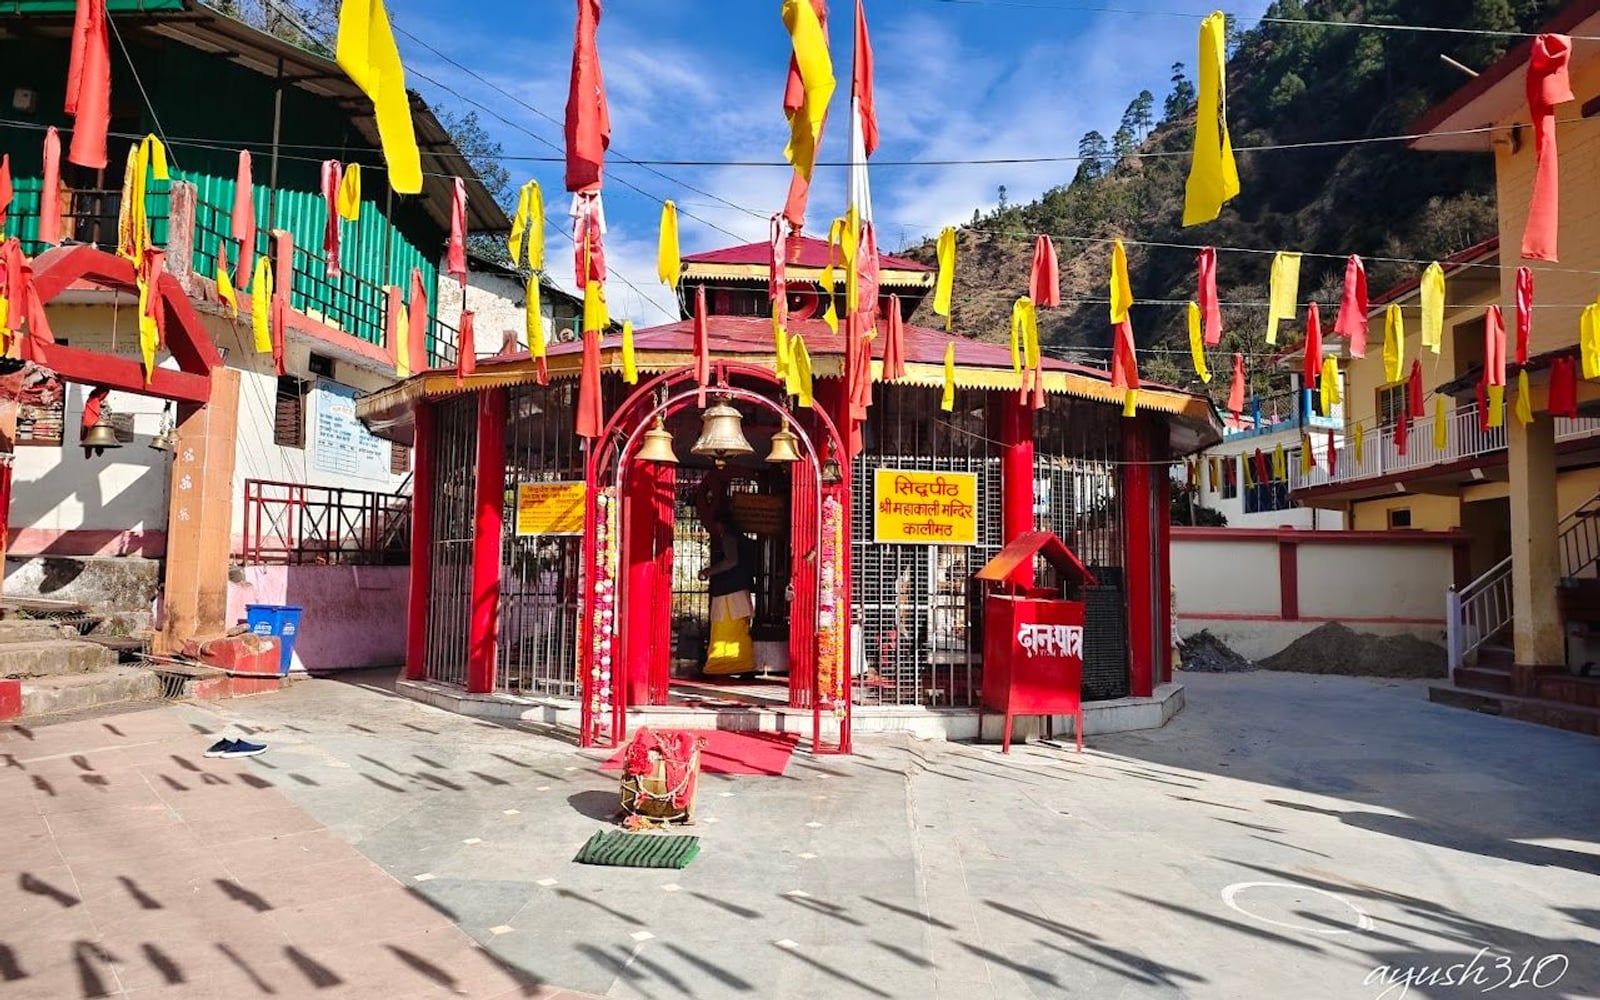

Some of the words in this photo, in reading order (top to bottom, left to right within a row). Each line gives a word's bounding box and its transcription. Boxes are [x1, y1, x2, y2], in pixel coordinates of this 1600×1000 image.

[880, 497, 892, 515] श्री
[893, 499, 940, 517] महाकाली
[942, 499, 974, 519] मन्दिर
[902, 518, 954, 537] कालीमठ
